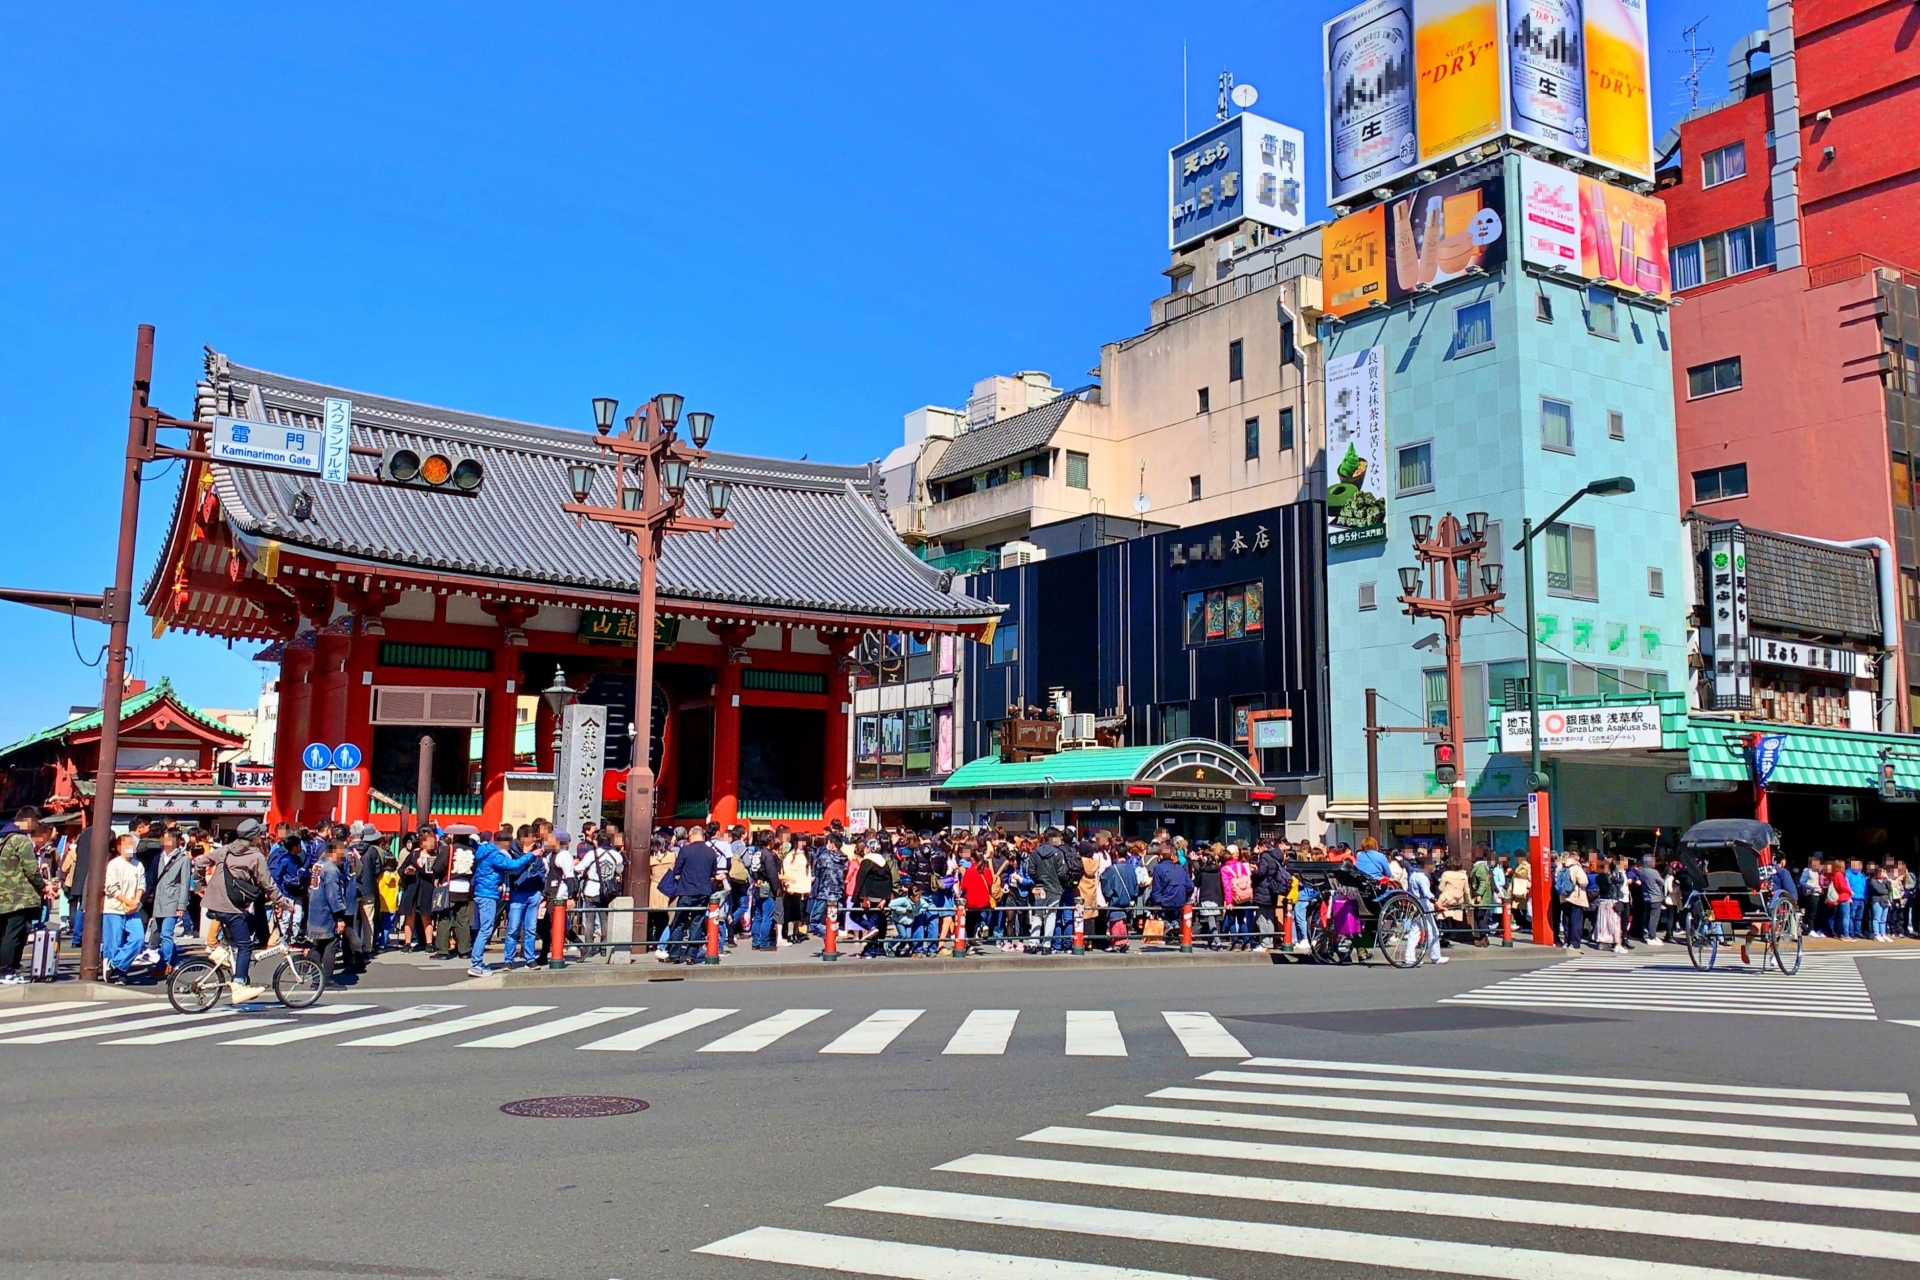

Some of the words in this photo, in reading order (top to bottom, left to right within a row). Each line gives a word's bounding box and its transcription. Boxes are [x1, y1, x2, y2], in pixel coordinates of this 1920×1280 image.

[1445, 40, 1474, 60] SUPER
[1539, 77, 1558, 99] 生
[1361, 120, 1382, 142] 生
[1541, 127, 1559, 141] 350ml
[1184, 141, 1230, 176] 天ぷら
[1400, 138, 1416, 159] お酒
[1363, 168, 1382, 183] 350ml
[1367, 351, 1382, 493] 良質な抹茶は苦くない。
[231, 424, 305, 451] 雷門
[327, 402, 345, 481] スクランブル式
[222, 444, 286, 463] Kaminarimon
[288, 452, 311, 467] Gate
[1230, 525, 1271, 555] 本店
[1715, 573, 1731, 621] 天ぷら
[1736, 576, 1746, 622] 天ぷら
[1767, 642, 1798, 663] 天ぷら
[1507, 715, 1541, 729] 地下
[1566, 713, 1602, 726] 銀座線
[1607, 712, 1644, 724] 浅草駅
[1566, 725, 1587, 734] Ginza
[1588, 724, 1604, 733] Line
[1607, 723, 1641, 732] Asakusa
[1642, 722, 1658, 731] Sta.
